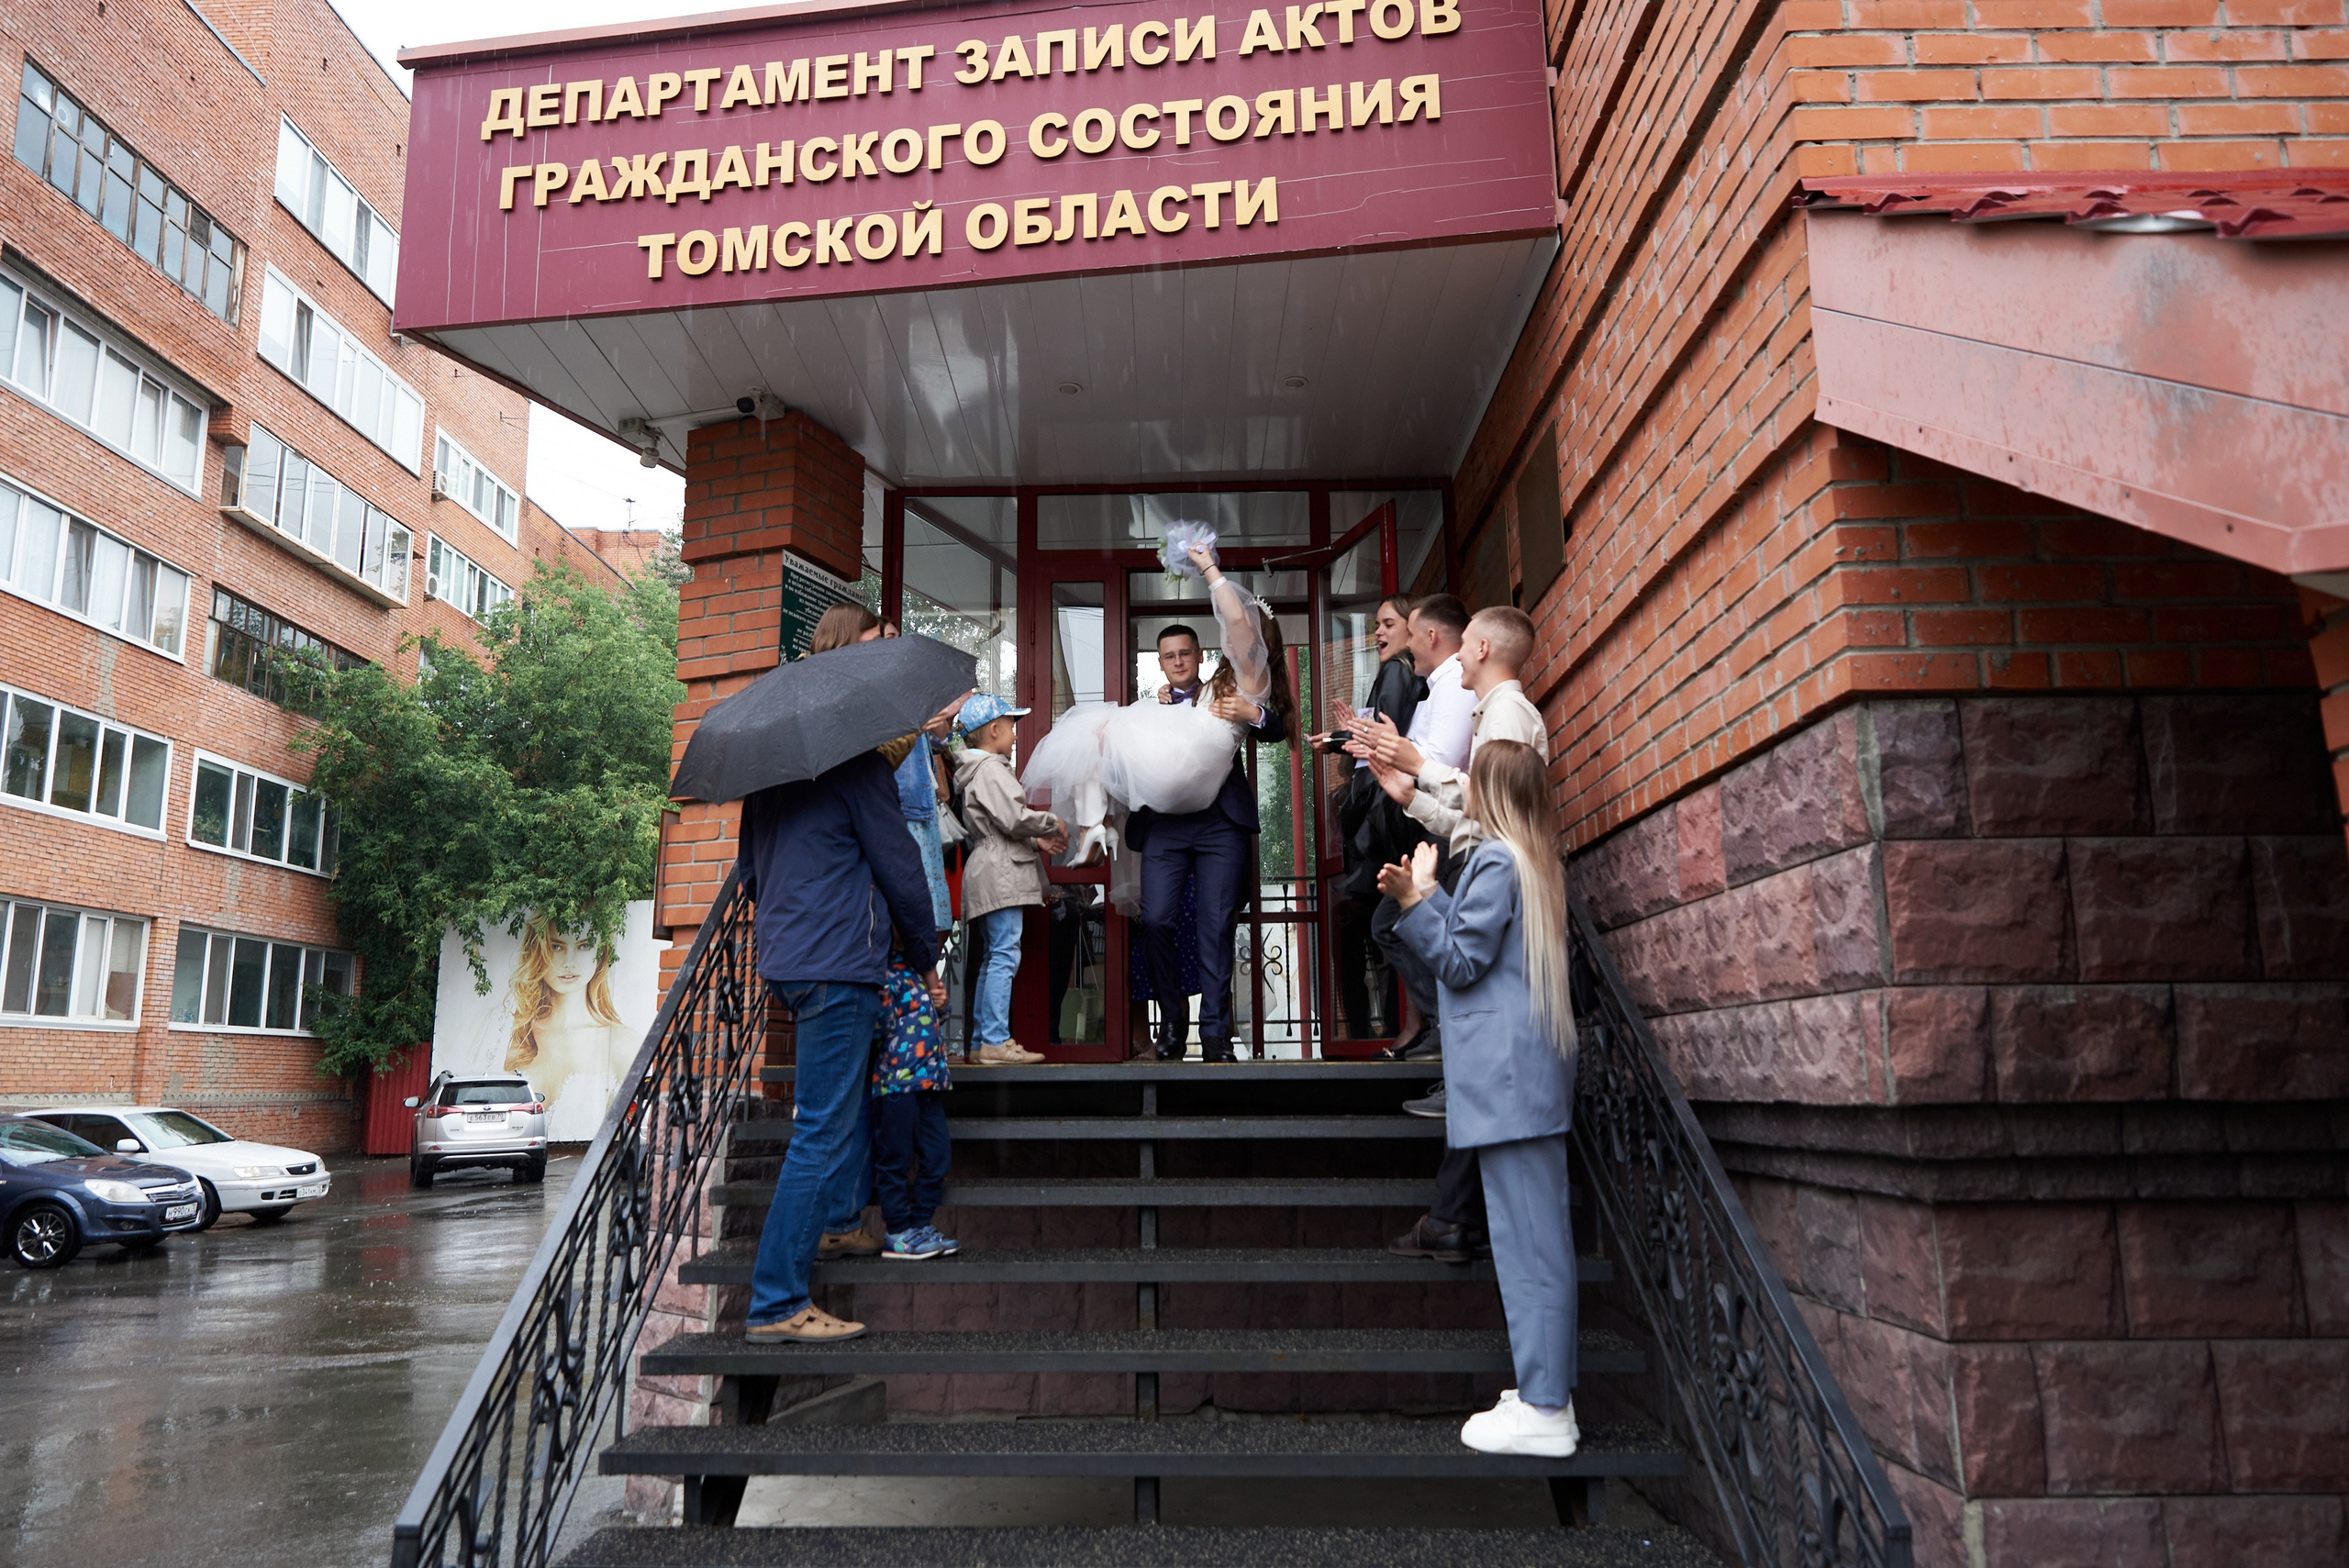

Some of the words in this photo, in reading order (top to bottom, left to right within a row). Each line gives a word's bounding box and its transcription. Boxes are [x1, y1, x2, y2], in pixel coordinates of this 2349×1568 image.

[481, 43, 935, 140] ДЕПАРТАМЕНТ
[953, 14, 1217, 83] ЗАПИСИ
[1238, 0, 1462, 56] АКТОВ
[498, 119, 1007, 210] ГРАЖДАНСКОГО
[1027, 73, 1441, 159] СОСТОЯНИЯ
[638, 199, 942, 279] ТОМСКОЙ
[965, 176, 1279, 250] ОБЛАСТИ
[785, 553, 829, 584] Уважаемые
